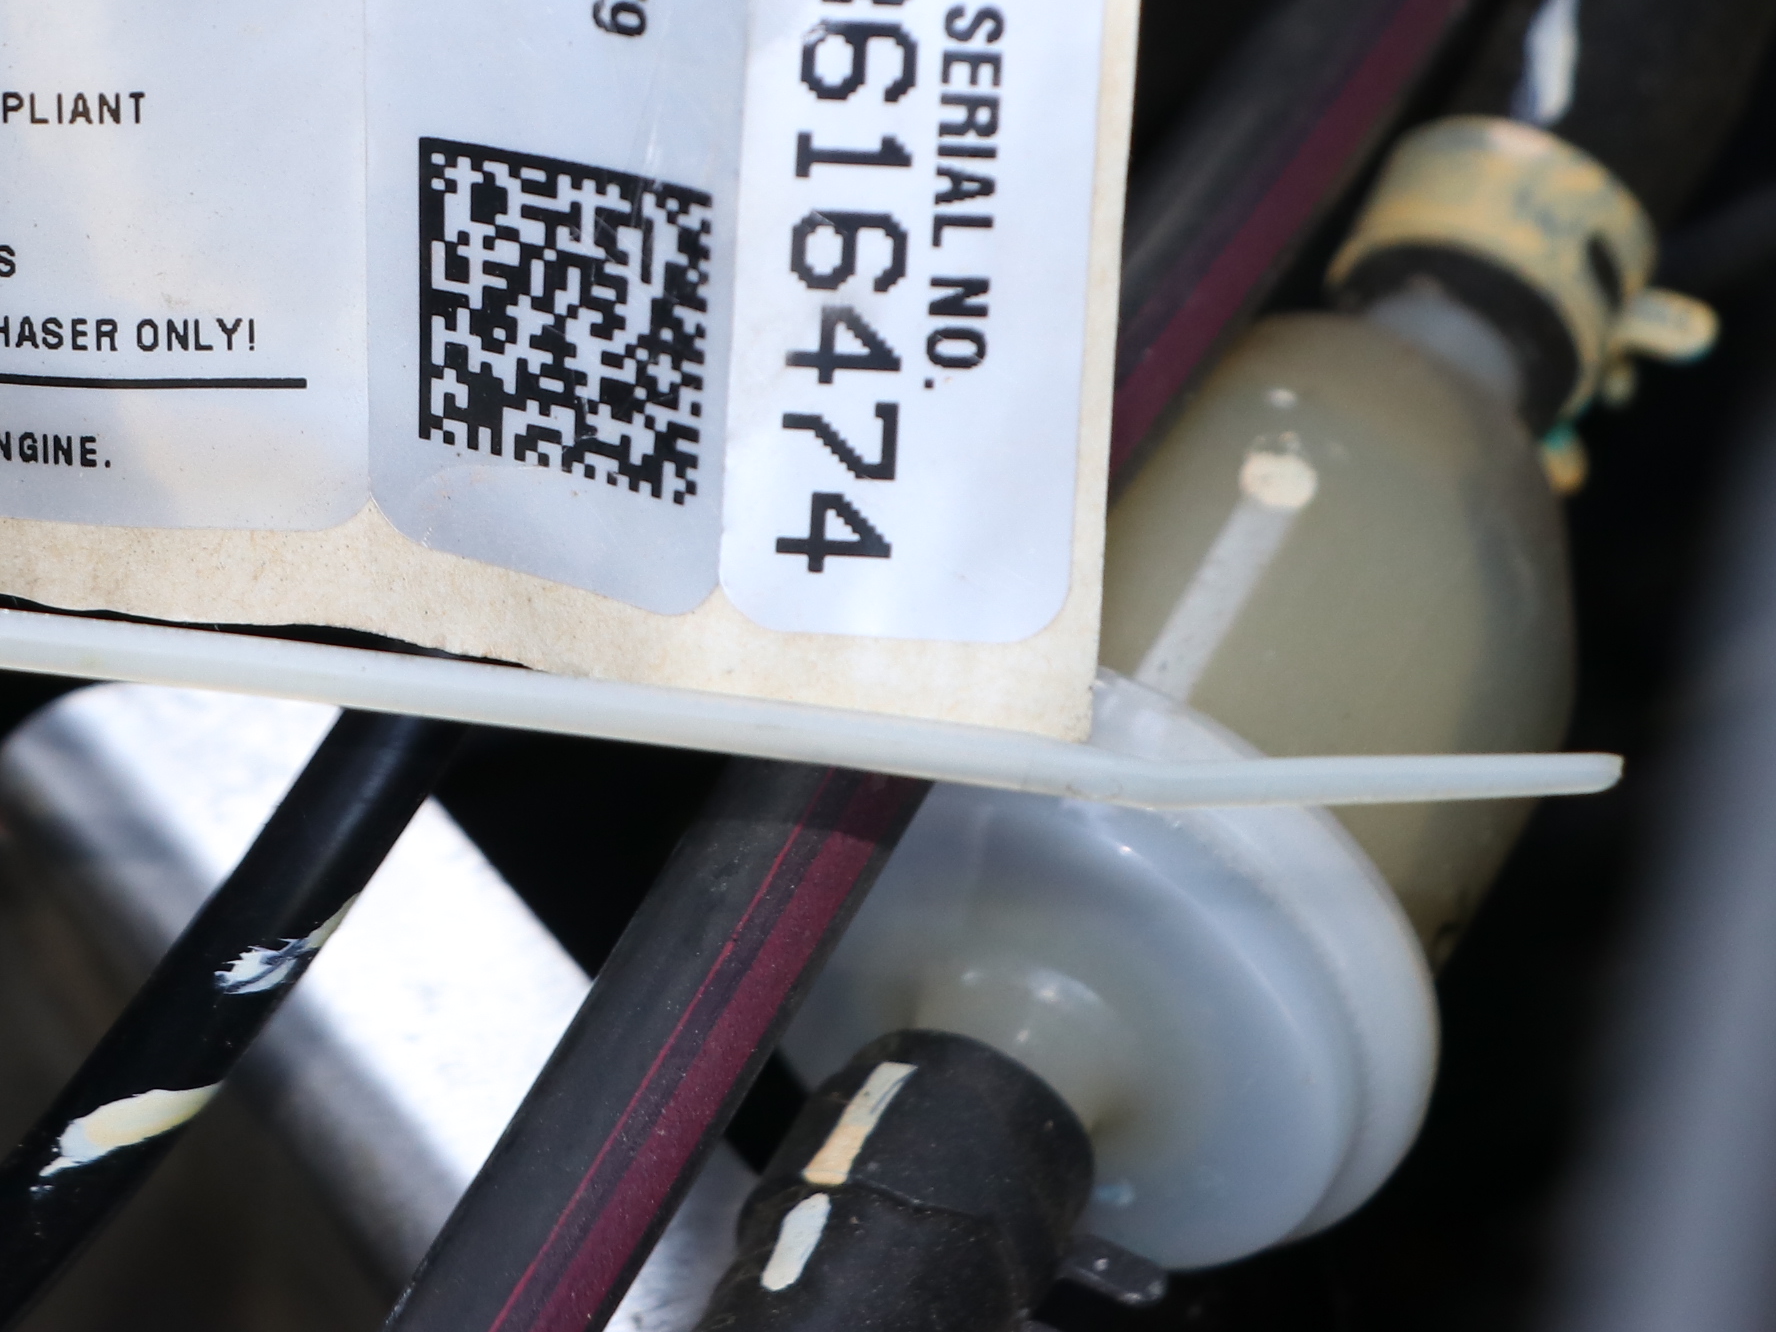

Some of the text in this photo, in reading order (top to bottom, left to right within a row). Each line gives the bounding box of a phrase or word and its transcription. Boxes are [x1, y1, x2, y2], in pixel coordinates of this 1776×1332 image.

[930, 5, 1005, 249] SERIAL
[136, 317, 257, 353] ONLY!
[922, 276, 992, 390] NO.
